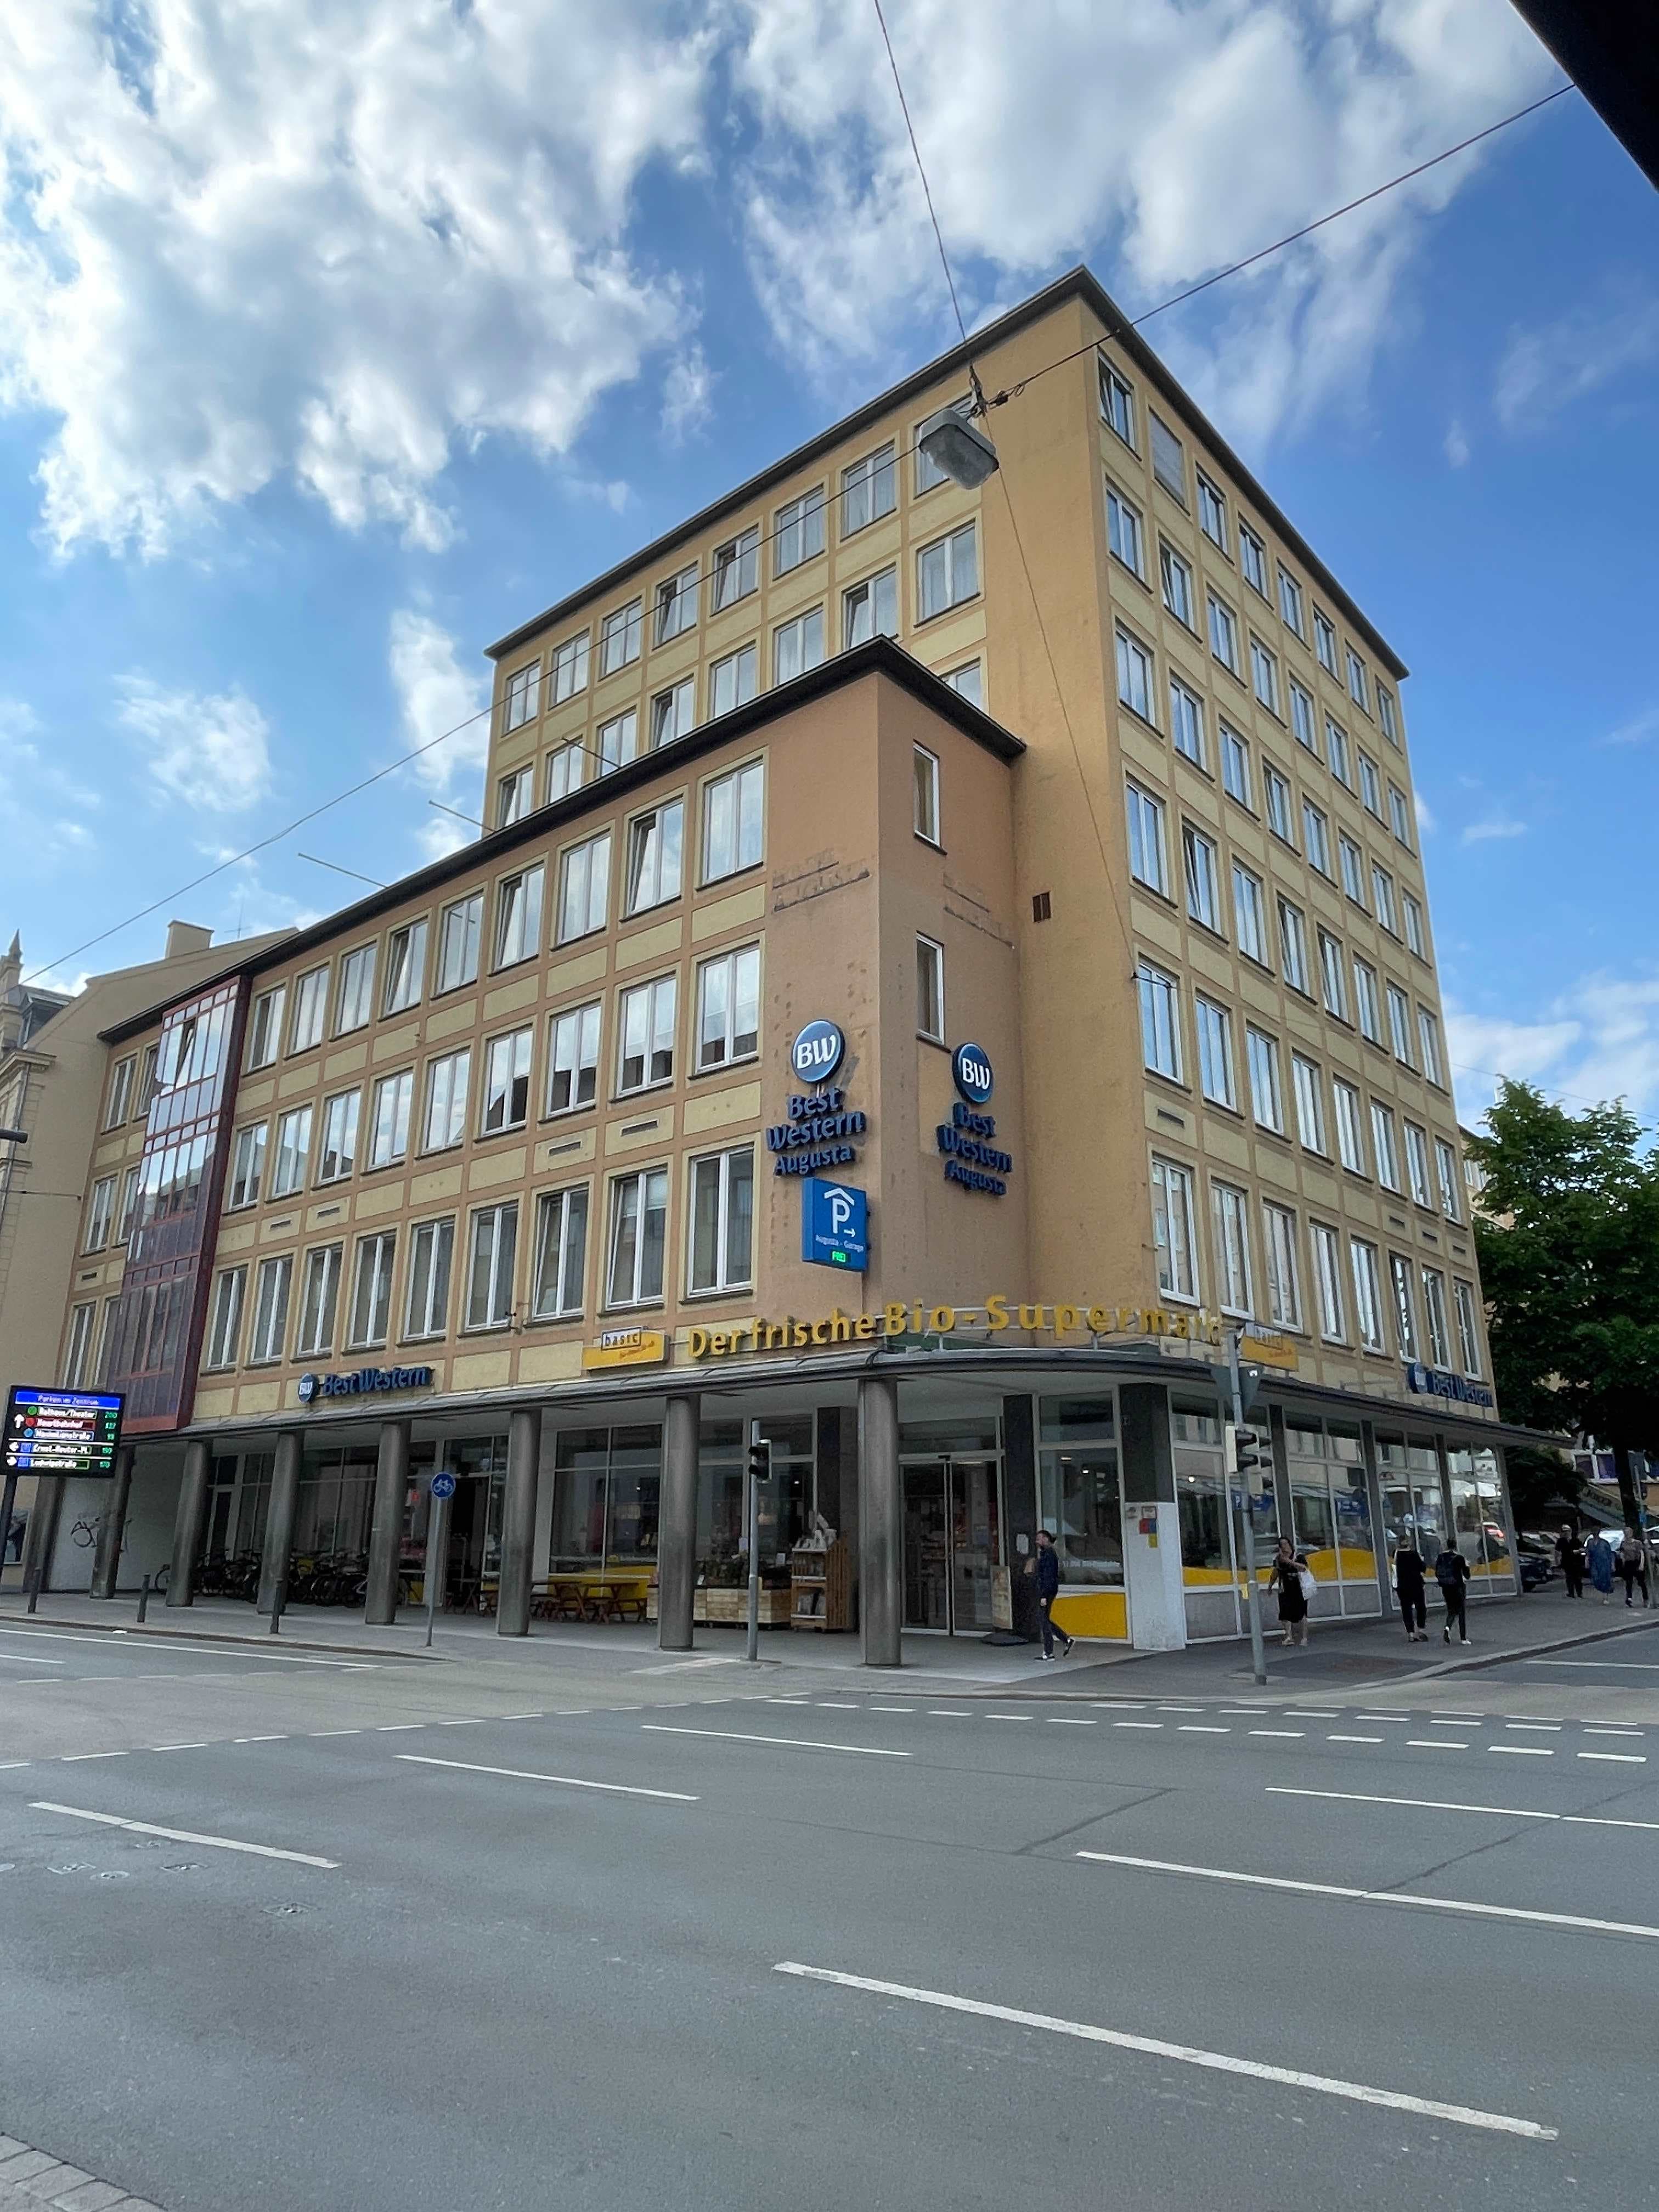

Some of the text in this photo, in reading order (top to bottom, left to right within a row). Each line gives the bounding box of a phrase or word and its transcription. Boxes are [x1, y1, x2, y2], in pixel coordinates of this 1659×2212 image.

[797, 1035, 836, 1069] BW
[962, 1057, 990, 1090] BW
[788, 1088, 842, 1120] Best
[955, 1103, 996, 1138] Best
[766, 1111, 865, 1151] Western
[774, 1144, 855, 1176] Augusta
[938, 1125, 1012, 1172] Western
[945, 1160, 1006, 1195] Augusta
[832, 1198, 850, 1234] P
[605, 1333, 638, 1347] basic
[689, 1328, 741, 1358] Der
[752, 1308, 876, 1351] frische
[323, 1373, 360, 1396] Best
[359, 1367, 430, 1393] Western
